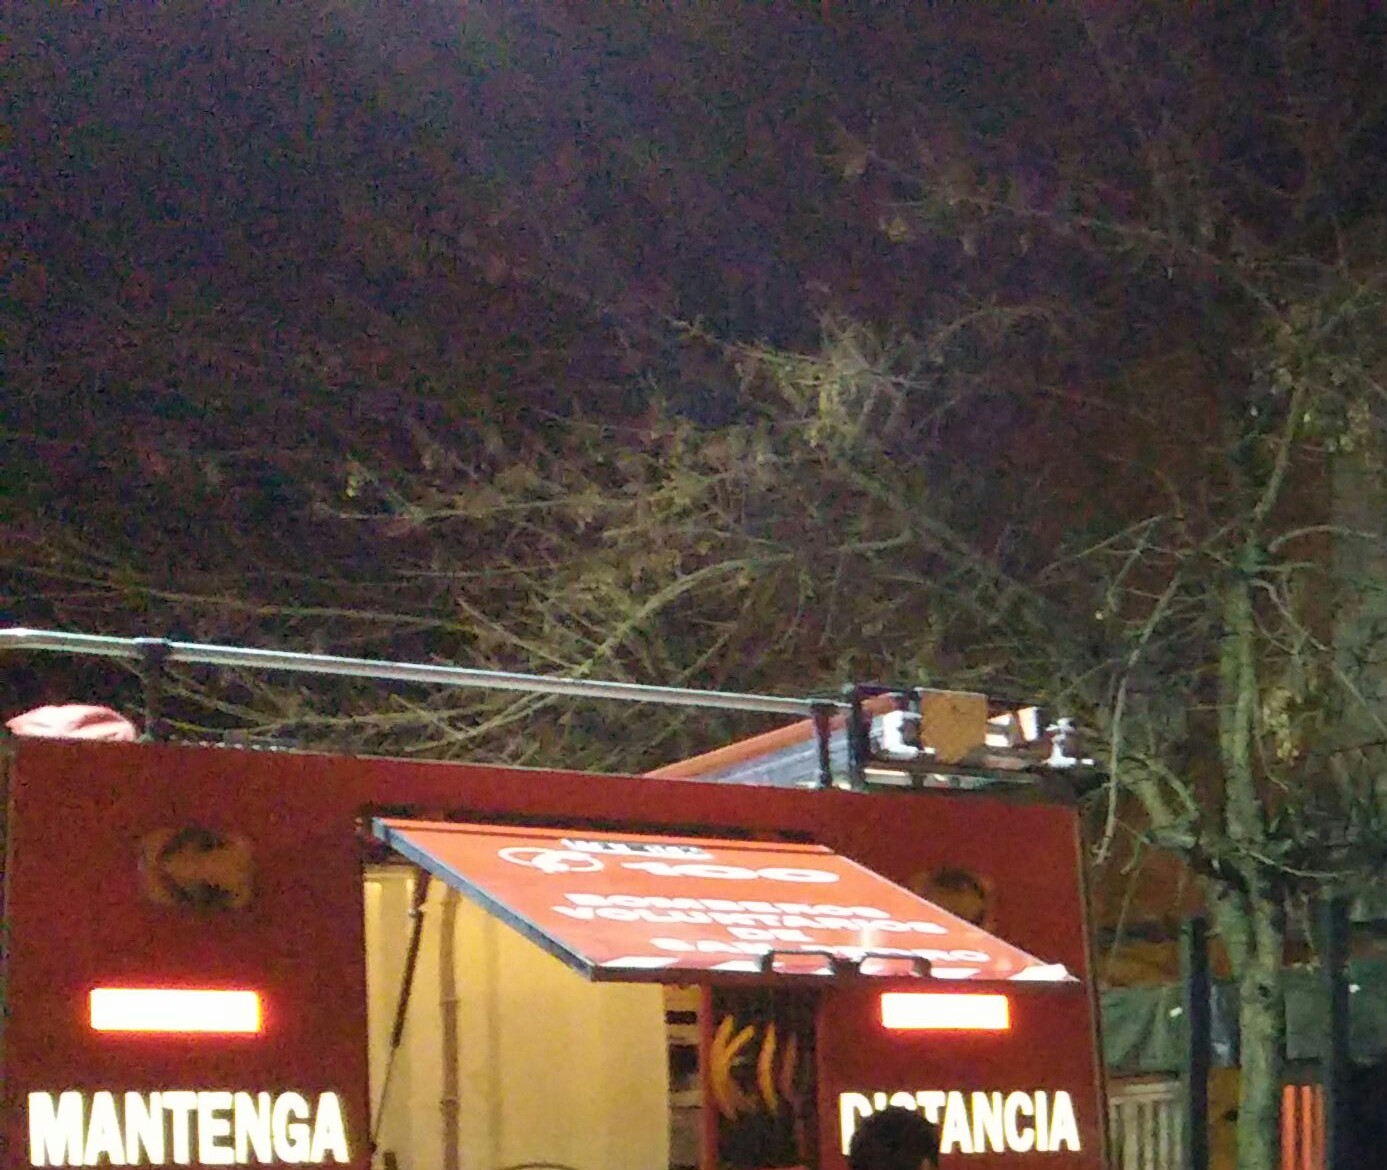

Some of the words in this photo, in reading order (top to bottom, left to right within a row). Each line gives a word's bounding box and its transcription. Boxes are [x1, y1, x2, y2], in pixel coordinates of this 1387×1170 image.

[622, 861, 840, 883] 100
[564, 893, 891, 919] BOMBEROS
[552, 905, 948, 935] VOLUNTARIOS
[727, 926, 815, 943] DE
[28, 1090, 350, 1167] MANTENGA
[839, 1090, 1082, 1156] DTANCIA
